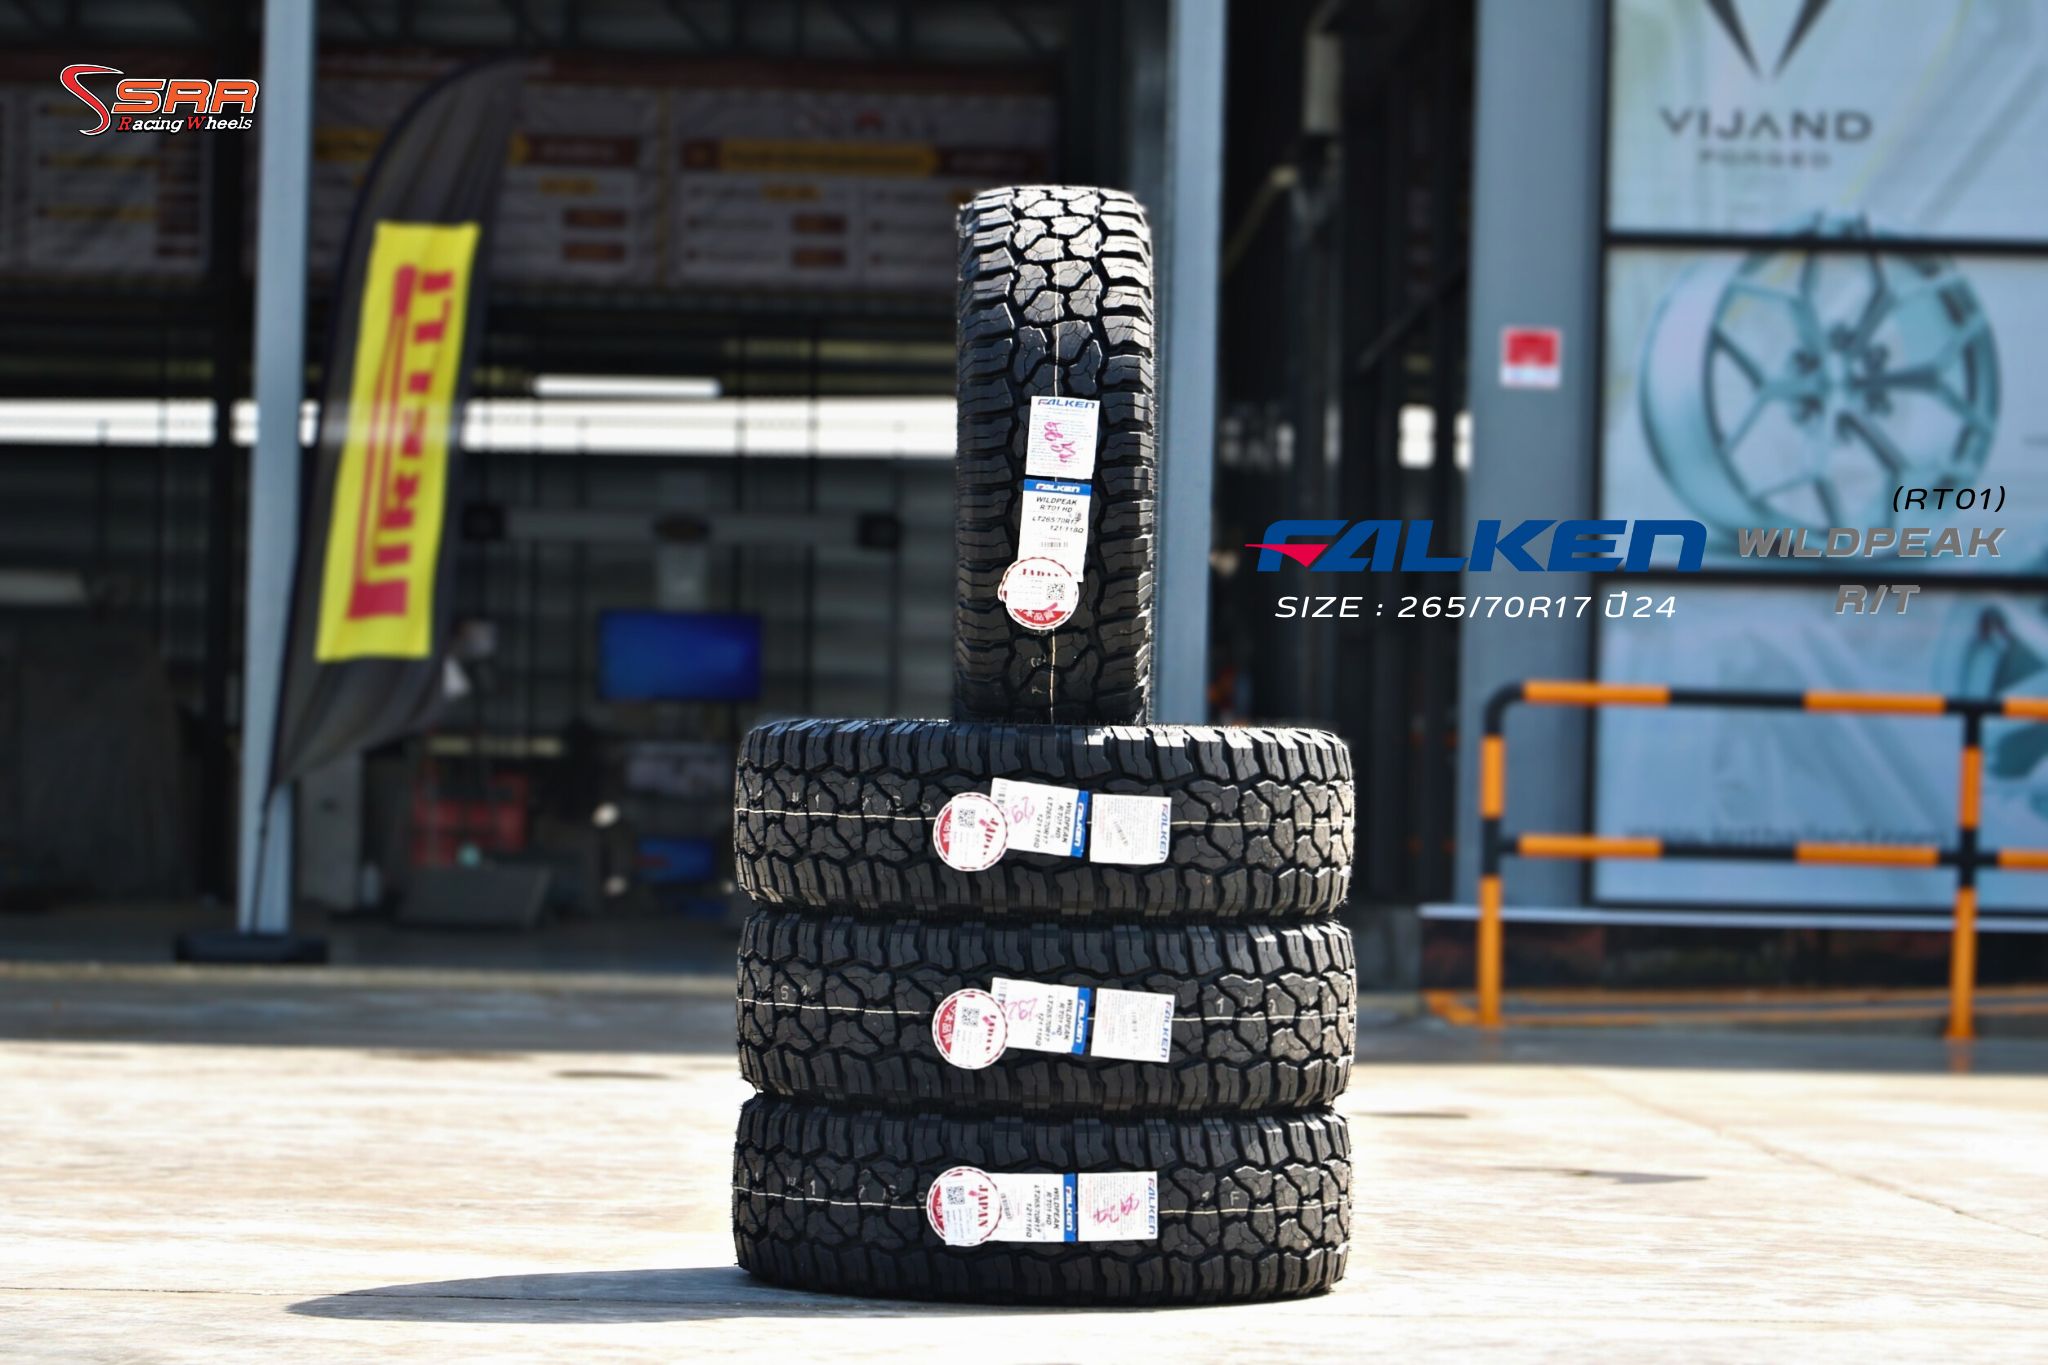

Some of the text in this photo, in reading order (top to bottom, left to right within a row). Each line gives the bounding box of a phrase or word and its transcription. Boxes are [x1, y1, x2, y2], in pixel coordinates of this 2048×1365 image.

[1658, 107, 1875, 142] VIJAND
[1037, 398, 1096, 410] FALKEN
[1035, 482, 1081, 494] FALKEN
[1036, 496, 1078, 506] WILDPEAK
[1063, 802, 1073, 845] WILDPEAK
[1073, 801, 1085, 848] FALKEN
[1159, 803, 1171, 861] FALKEN
[1064, 999, 1074, 1041] WILDPEAK
[1075, 999, 1086, 1044] FALKEN
[1159, 1001, 1172, 1059] FALKEN
[978, 1184, 989, 1228] JAPAN
[1064, 1186, 1073, 1231] FALKEN
[1147, 1177, 1157, 1235] FALKEN
